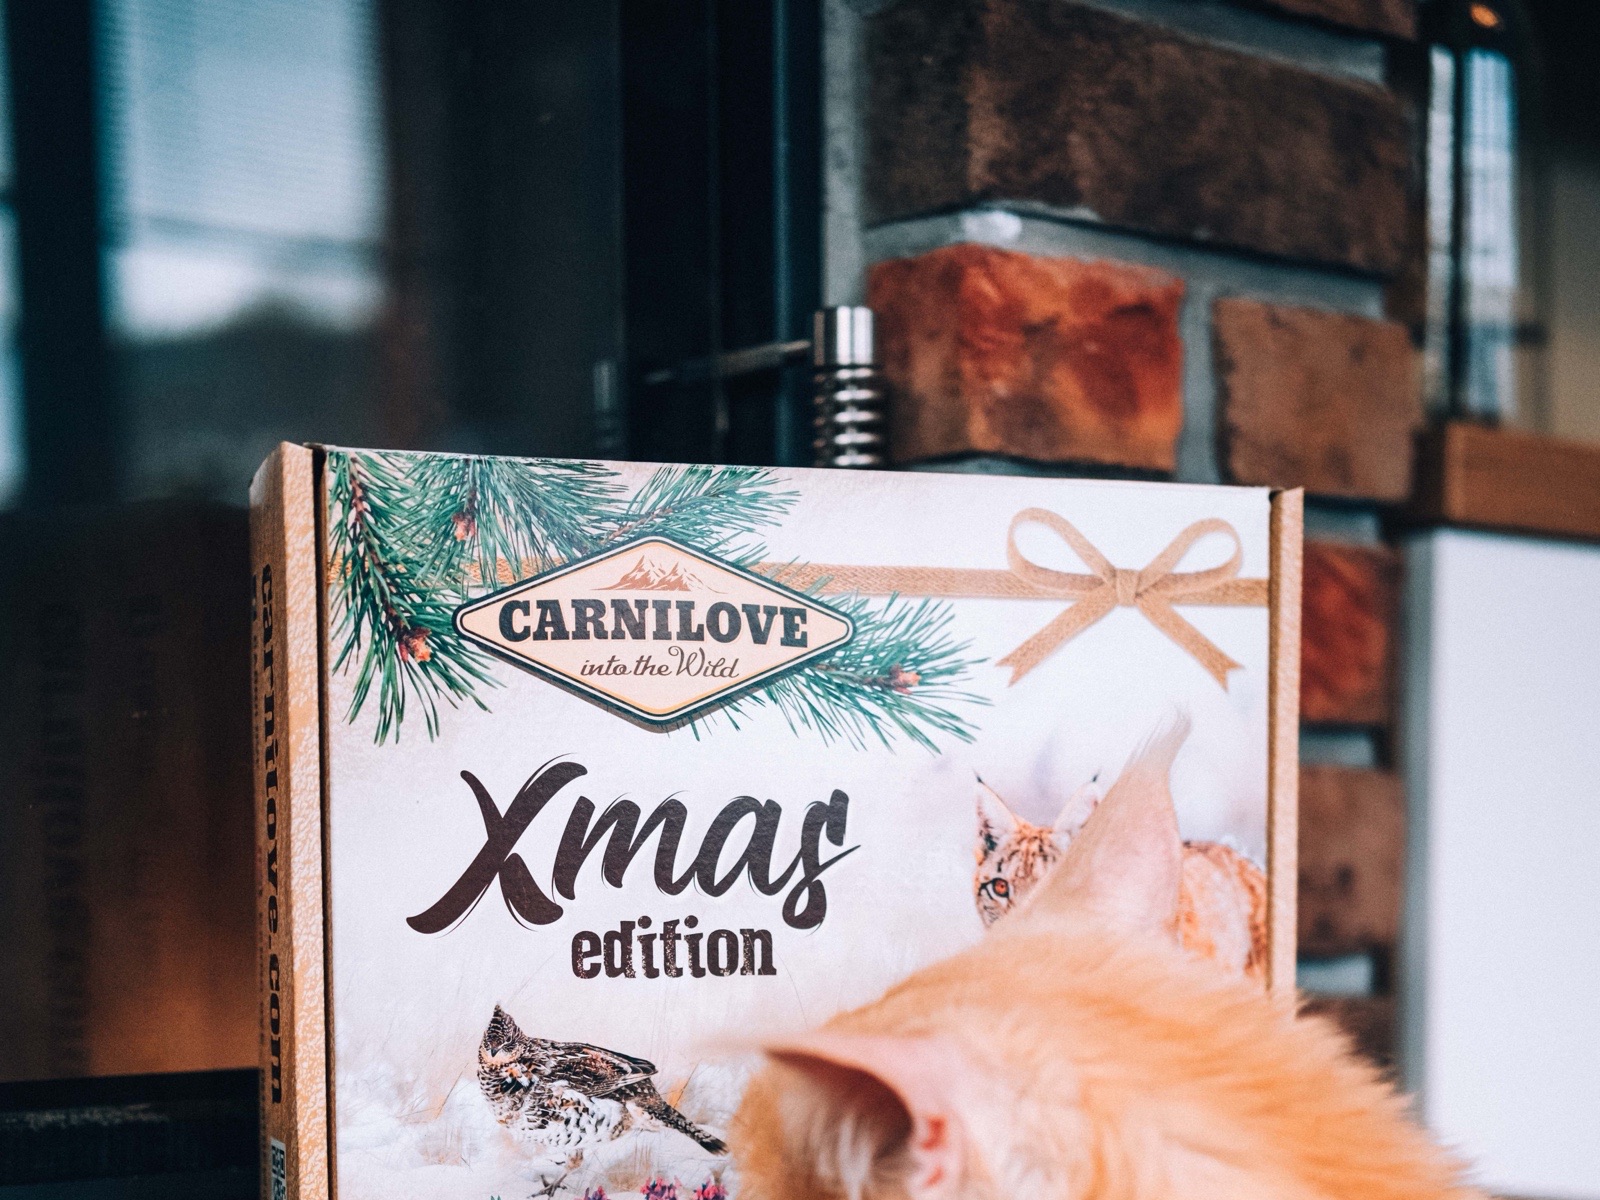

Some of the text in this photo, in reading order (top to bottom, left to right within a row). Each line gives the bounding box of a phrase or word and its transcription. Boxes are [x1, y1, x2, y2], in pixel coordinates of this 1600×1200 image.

[498, 598, 808, 647] CARNILOVE
[580, 645, 740, 679] into the Wild
[261, 563, 282, 1105] carnilove.com
[405, 753, 862, 935] Xmas
[570, 914, 778, 980] edition
